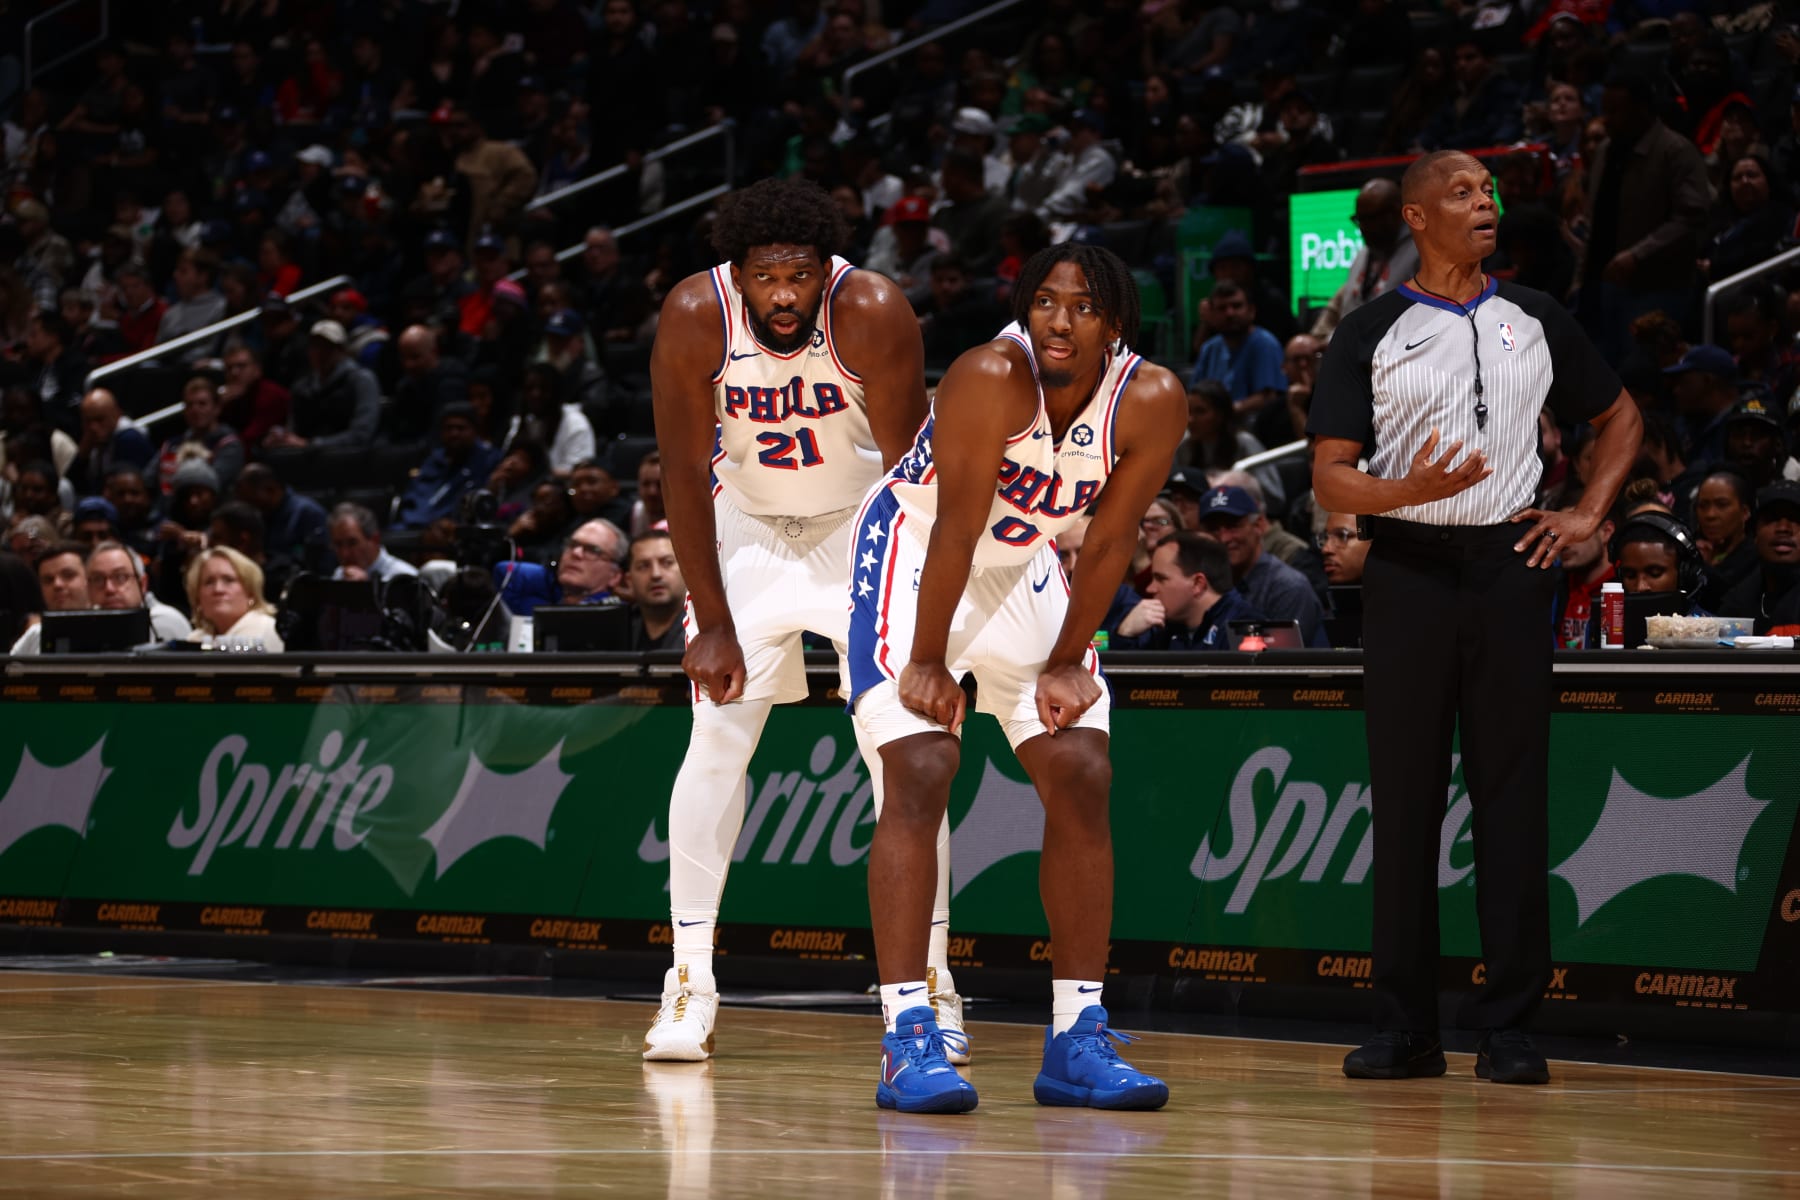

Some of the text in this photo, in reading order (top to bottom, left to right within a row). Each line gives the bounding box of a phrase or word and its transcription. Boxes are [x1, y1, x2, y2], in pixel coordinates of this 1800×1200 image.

[725, 376, 849, 423] PHILA
[756, 428, 824, 470] 21
[991, 516, 1042, 546] 0
[166, 729, 394, 876] Sprite
